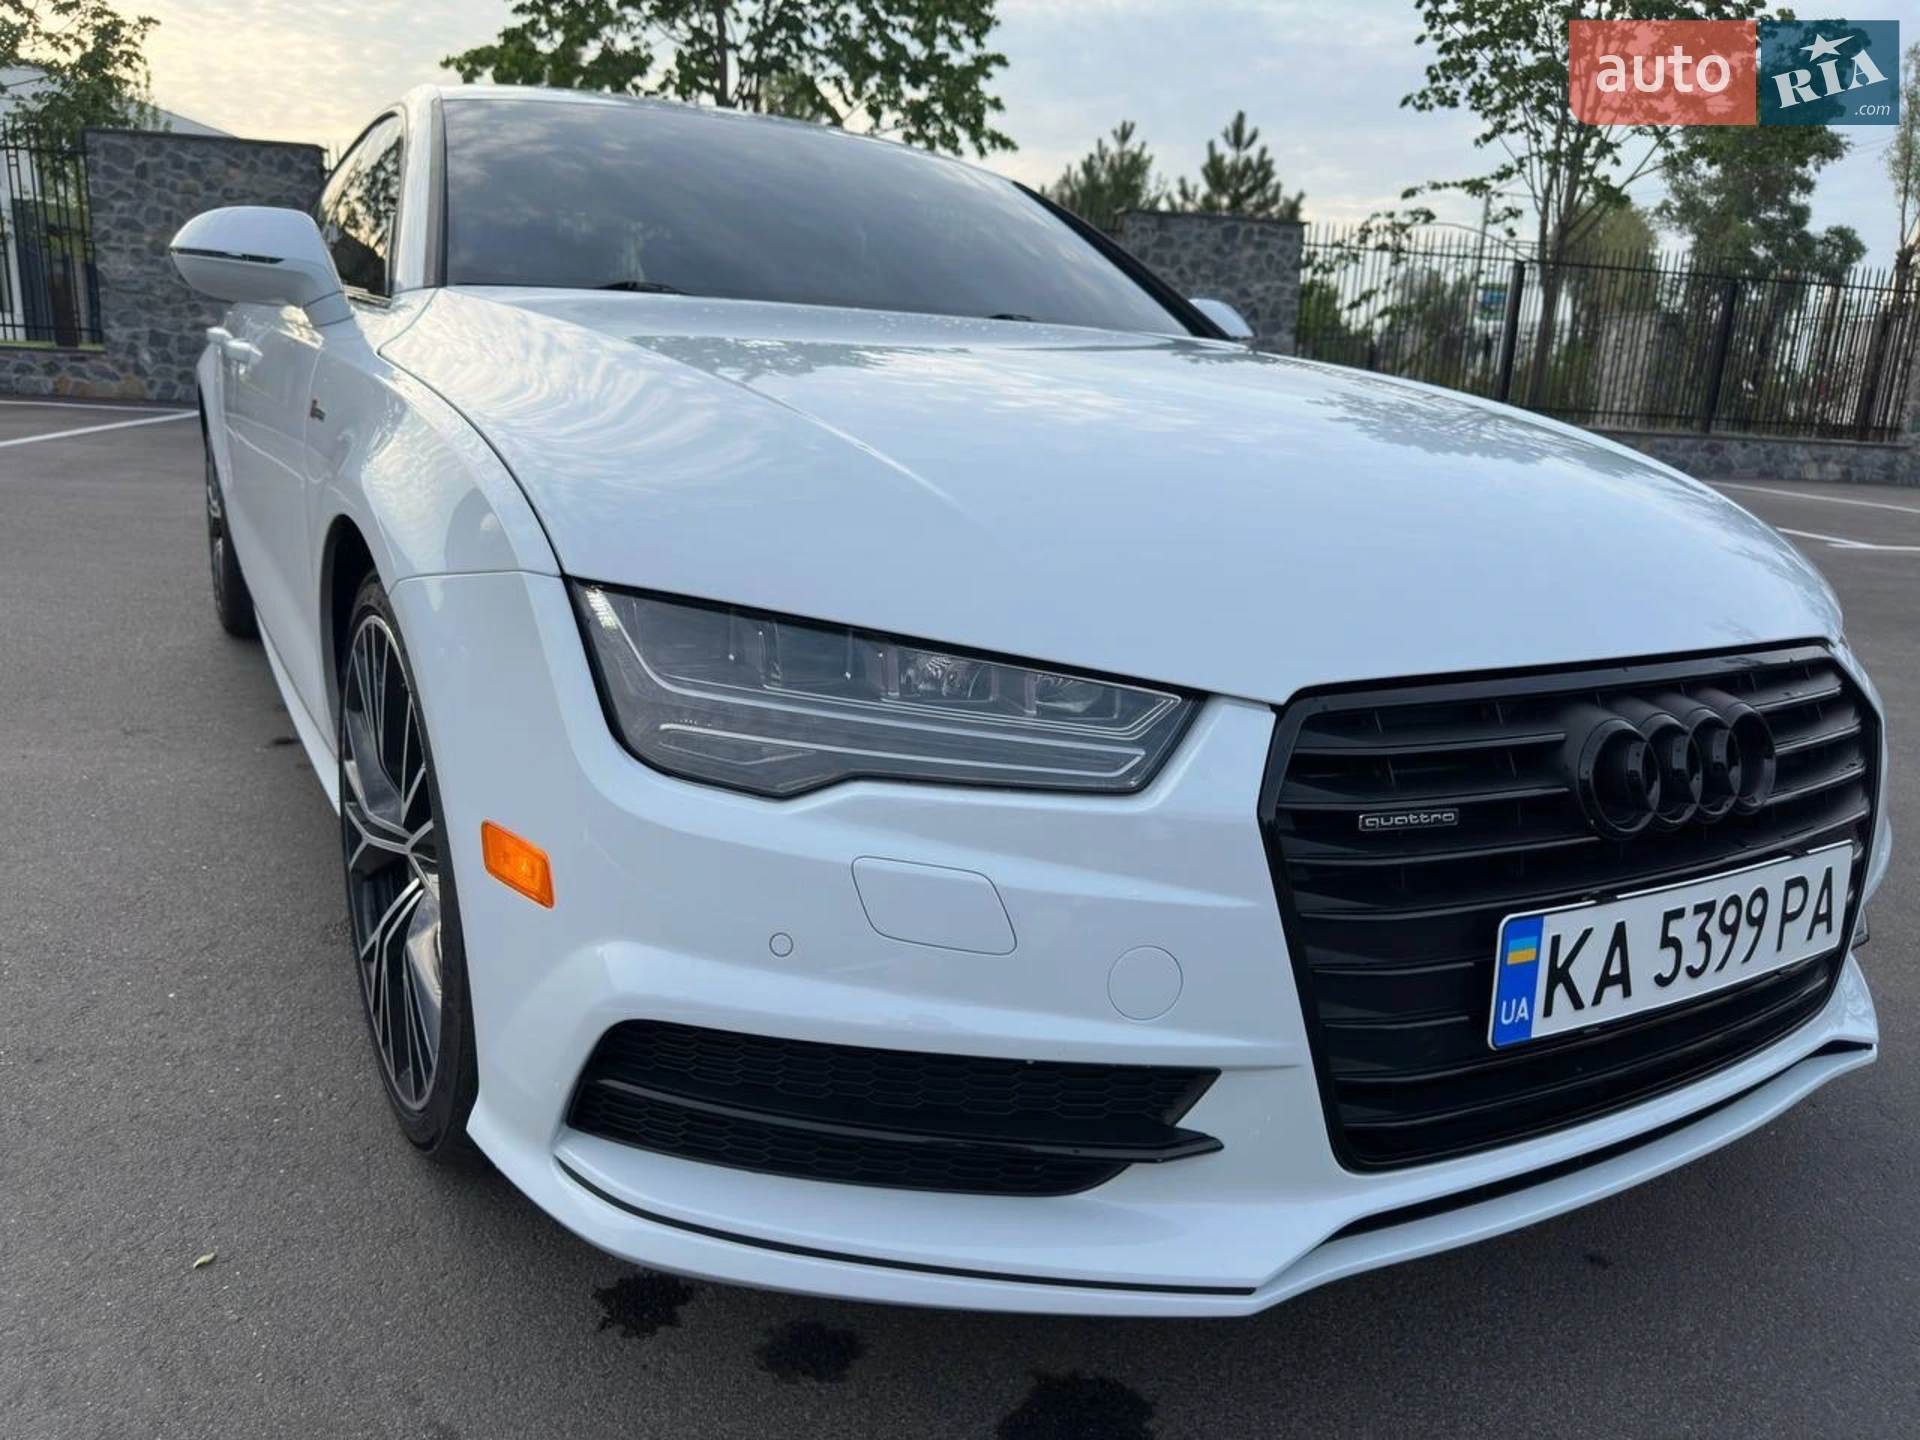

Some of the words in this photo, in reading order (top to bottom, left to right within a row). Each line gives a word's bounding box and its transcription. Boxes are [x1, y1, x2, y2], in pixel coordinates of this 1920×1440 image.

[1365, 813, 1455, 828] quattro
[1542, 920, 1632, 1018] KA
[1653, 886, 1769, 988] 5399
[1775, 866, 1833, 952] PA
[1500, 996, 1530, 1025] UA
